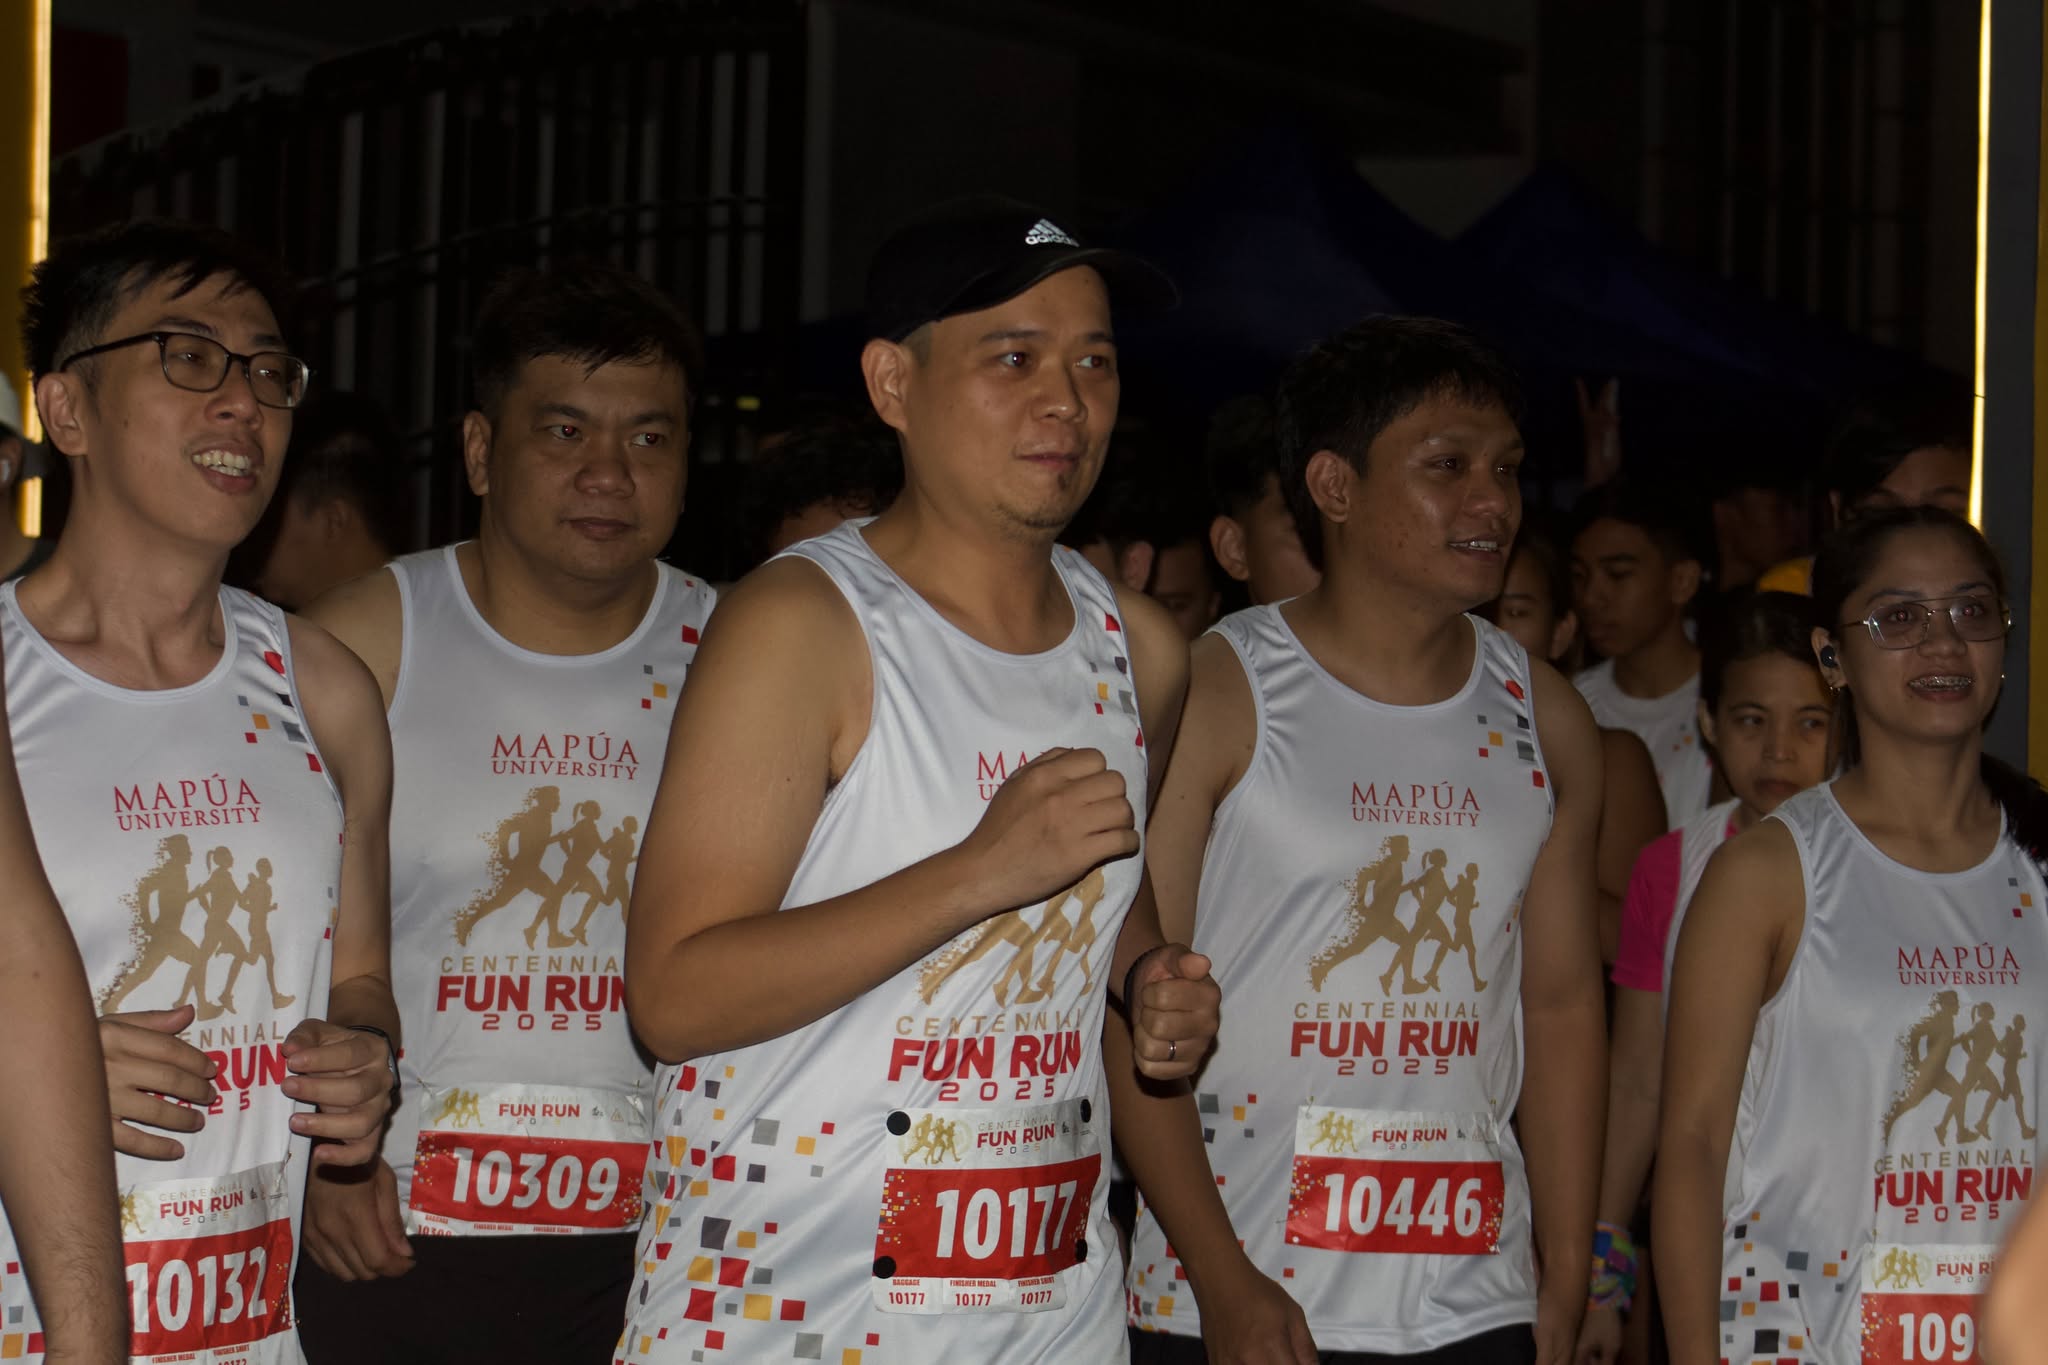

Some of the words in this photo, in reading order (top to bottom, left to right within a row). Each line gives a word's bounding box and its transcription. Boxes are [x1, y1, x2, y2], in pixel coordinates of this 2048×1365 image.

[490, 731, 639, 764] MAPÚA
[492, 760, 639, 780] UNIVERSITY
[113, 773, 262, 814] MAPÚA
[1351, 781, 1481, 811] MAPÚA
[116, 806, 262, 831] UNIVERSITY
[1352, 807, 1480, 827] UNIVERSITY
[441, 955, 618, 973] CENTENNIA
[1897, 942, 2021, 970] MAPÚA
[1899, 970, 2021, 985] UNIVERSITY
[437, 975, 530, 1012] FUN
[481, 1014, 603, 1031] 2025
[1294, 1001, 1479, 1019] CENTENNIAL
[177, 1021, 285, 1048] ENNIAL
[1291, 1021, 1386, 1057] FUN
[1398, 1021, 1480, 1057] RUN
[887, 1035, 995, 1082] FUN
[1009, 1030, 1081, 1078] RUN
[1337, 1059, 1449, 1076] 2025
[938, 1078, 1055, 1102] 2025
[499, 1103, 536, 1118] FUN
[542, 1103, 580, 1118] RUN
[977, 1130, 1016, 1148] FUN
[1023, 1123, 1055, 1143] RUN
[1372, 1130, 1407, 1143] FUN
[1413, 1128, 1447, 1142] RUN
[1873, 1149, 2031, 1175] CENTENNIAL
[453, 1146, 620, 1212] 10309
[1955, 1166, 2033, 1204] RUN
[160, 1199, 204, 1219] FUN
[210, 1190, 244, 1213] RUN
[1324, 1173, 1482, 1237] 10446
[1904, 1203, 2000, 1224] 2025
[935, 1179, 1078, 1260] 10177
[1936, 1263, 1973, 1276] FUN
[126, 1246, 267, 1333] 10132
[888, 1292, 925, 1305] 10177
[955, 1293, 992, 1306] 10177
[1021, 1290, 1052, 1305] 10177
[1898, 1312, 1976, 1362] 109
